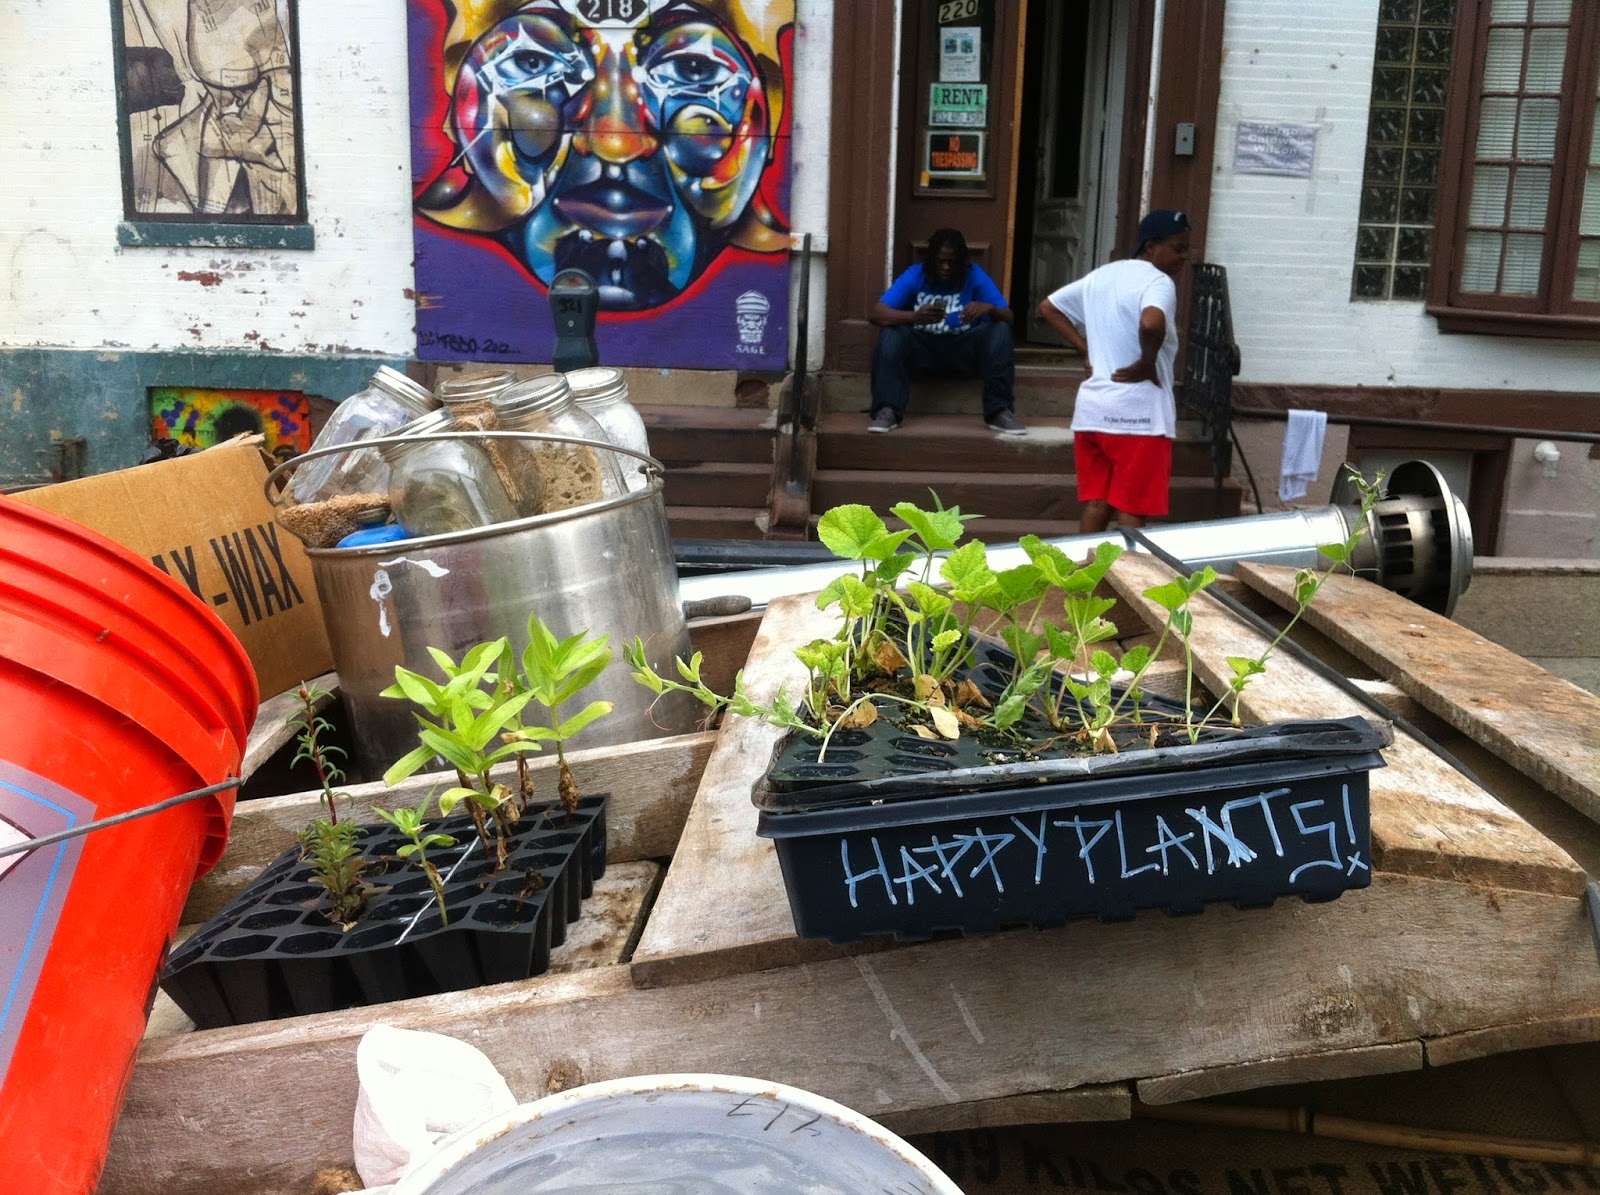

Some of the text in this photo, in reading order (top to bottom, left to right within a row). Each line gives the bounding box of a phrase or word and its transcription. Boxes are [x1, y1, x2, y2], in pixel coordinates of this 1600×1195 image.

[587, 0, 633, 18] 218
[940, 0, 977, 23] 220
[941, 88, 983, 106] RENT
[735, 344, 766, 355] SAGE
[840, 810, 1048, 908] HAPPY
